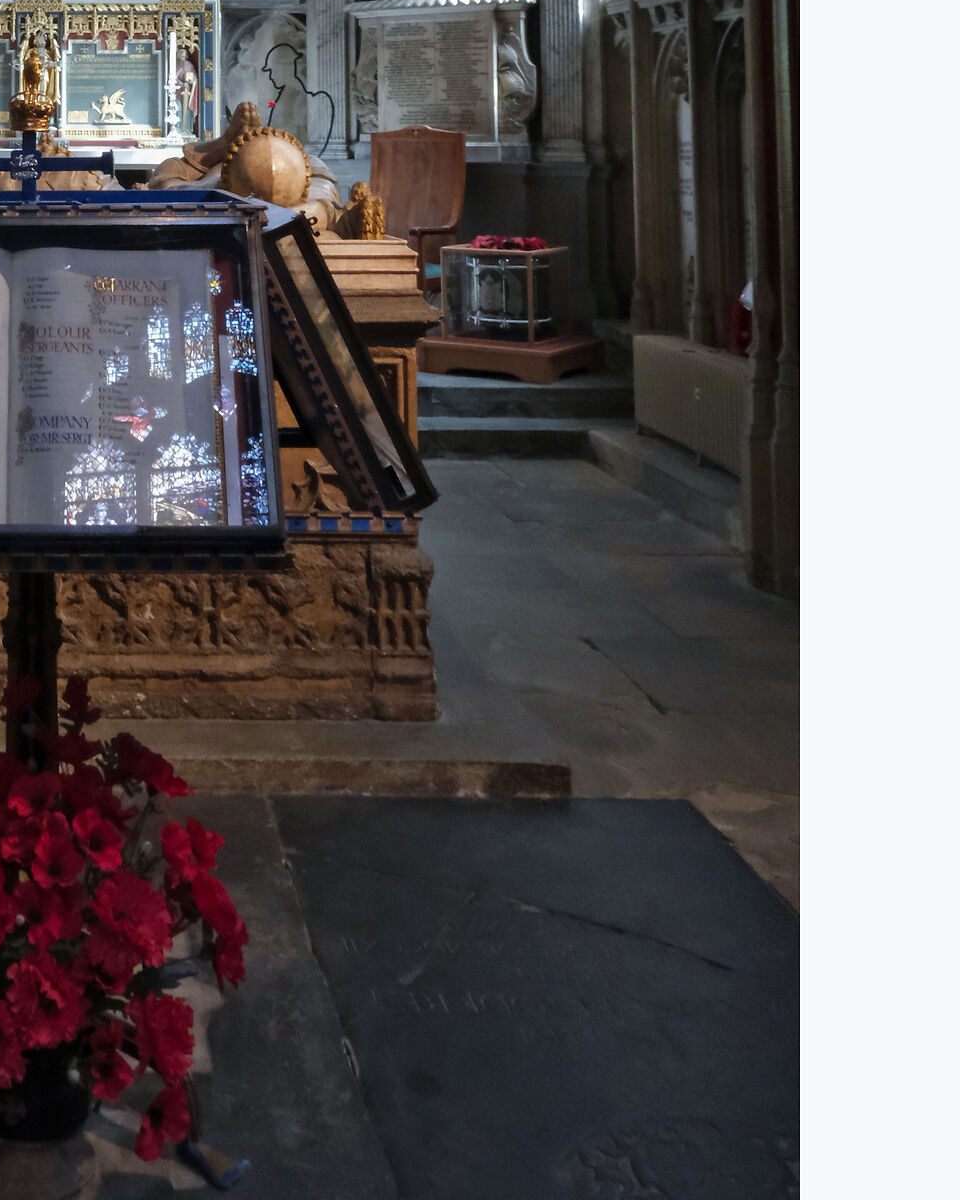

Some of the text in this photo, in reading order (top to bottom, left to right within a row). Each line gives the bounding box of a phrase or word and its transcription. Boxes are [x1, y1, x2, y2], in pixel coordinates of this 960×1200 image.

[101, 294, 169, 308] OFFICERS
[24, 325, 92, 341] OLOUR
[24, 341, 94, 356] SERGEANTS
[20, 414, 91, 430] OMPANY
